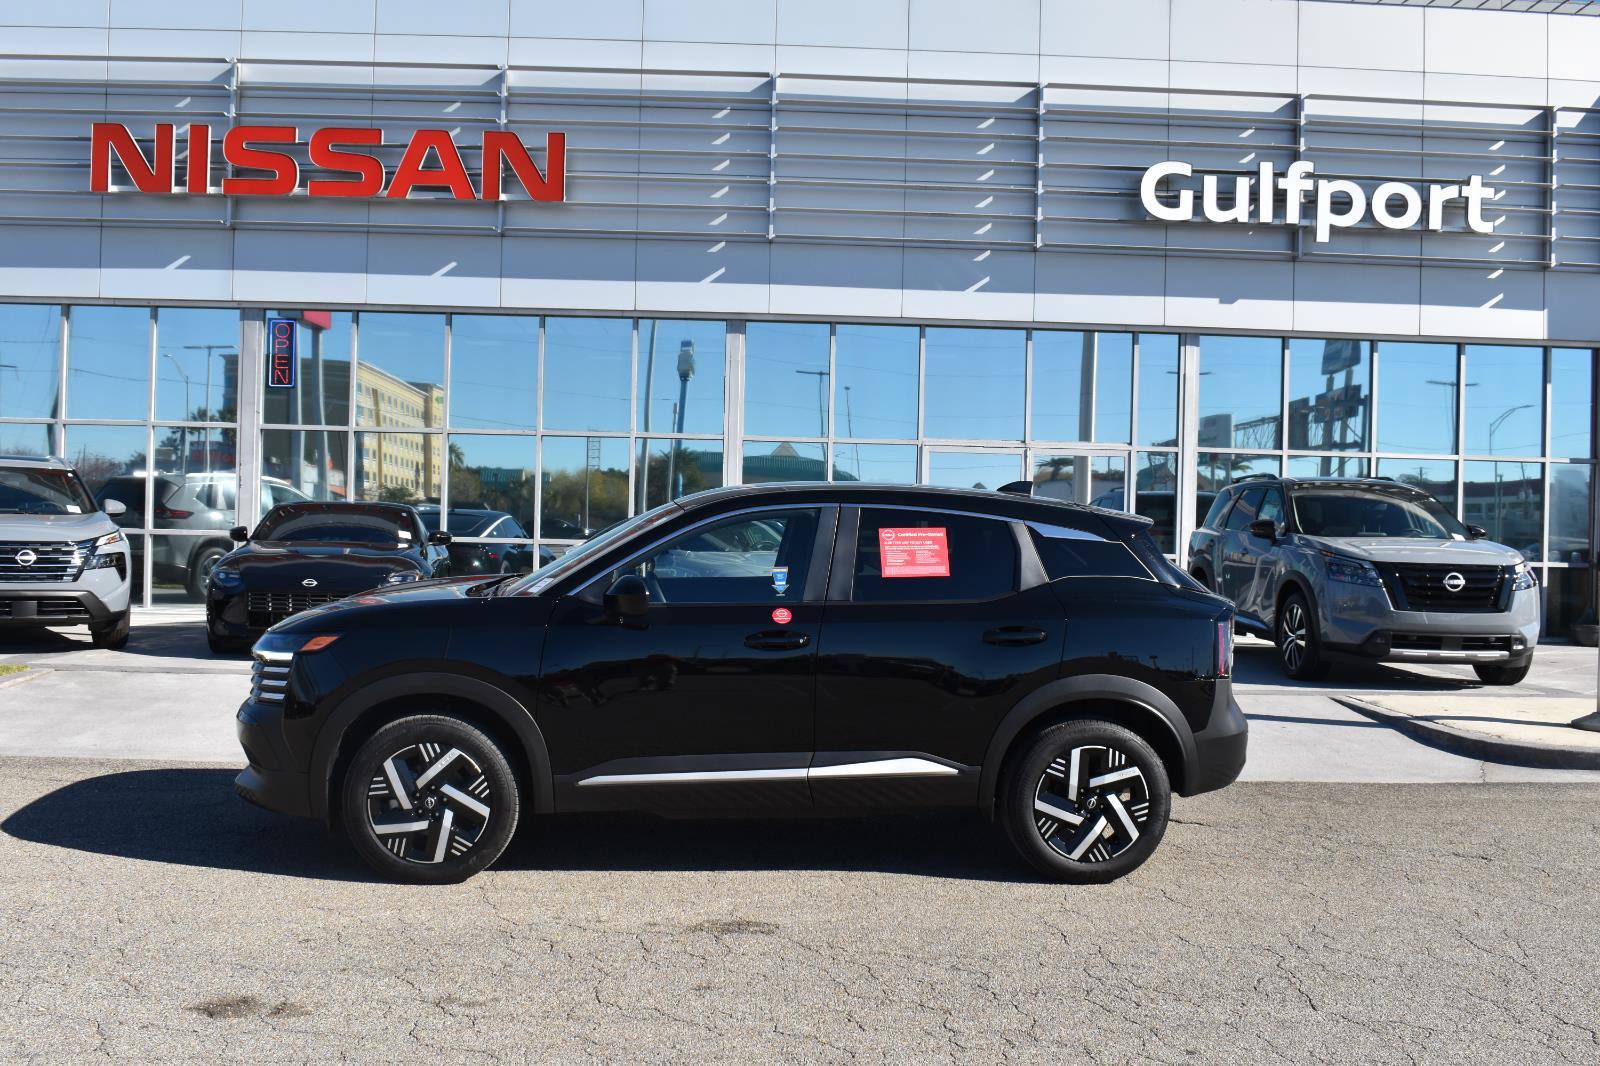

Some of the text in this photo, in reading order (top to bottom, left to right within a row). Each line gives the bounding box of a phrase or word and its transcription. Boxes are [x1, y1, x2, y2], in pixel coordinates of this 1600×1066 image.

[90, 122, 566, 202] NISSAN
[1140, 160, 1496, 243] Gulfport
[274, 323, 291, 384] OPEN
